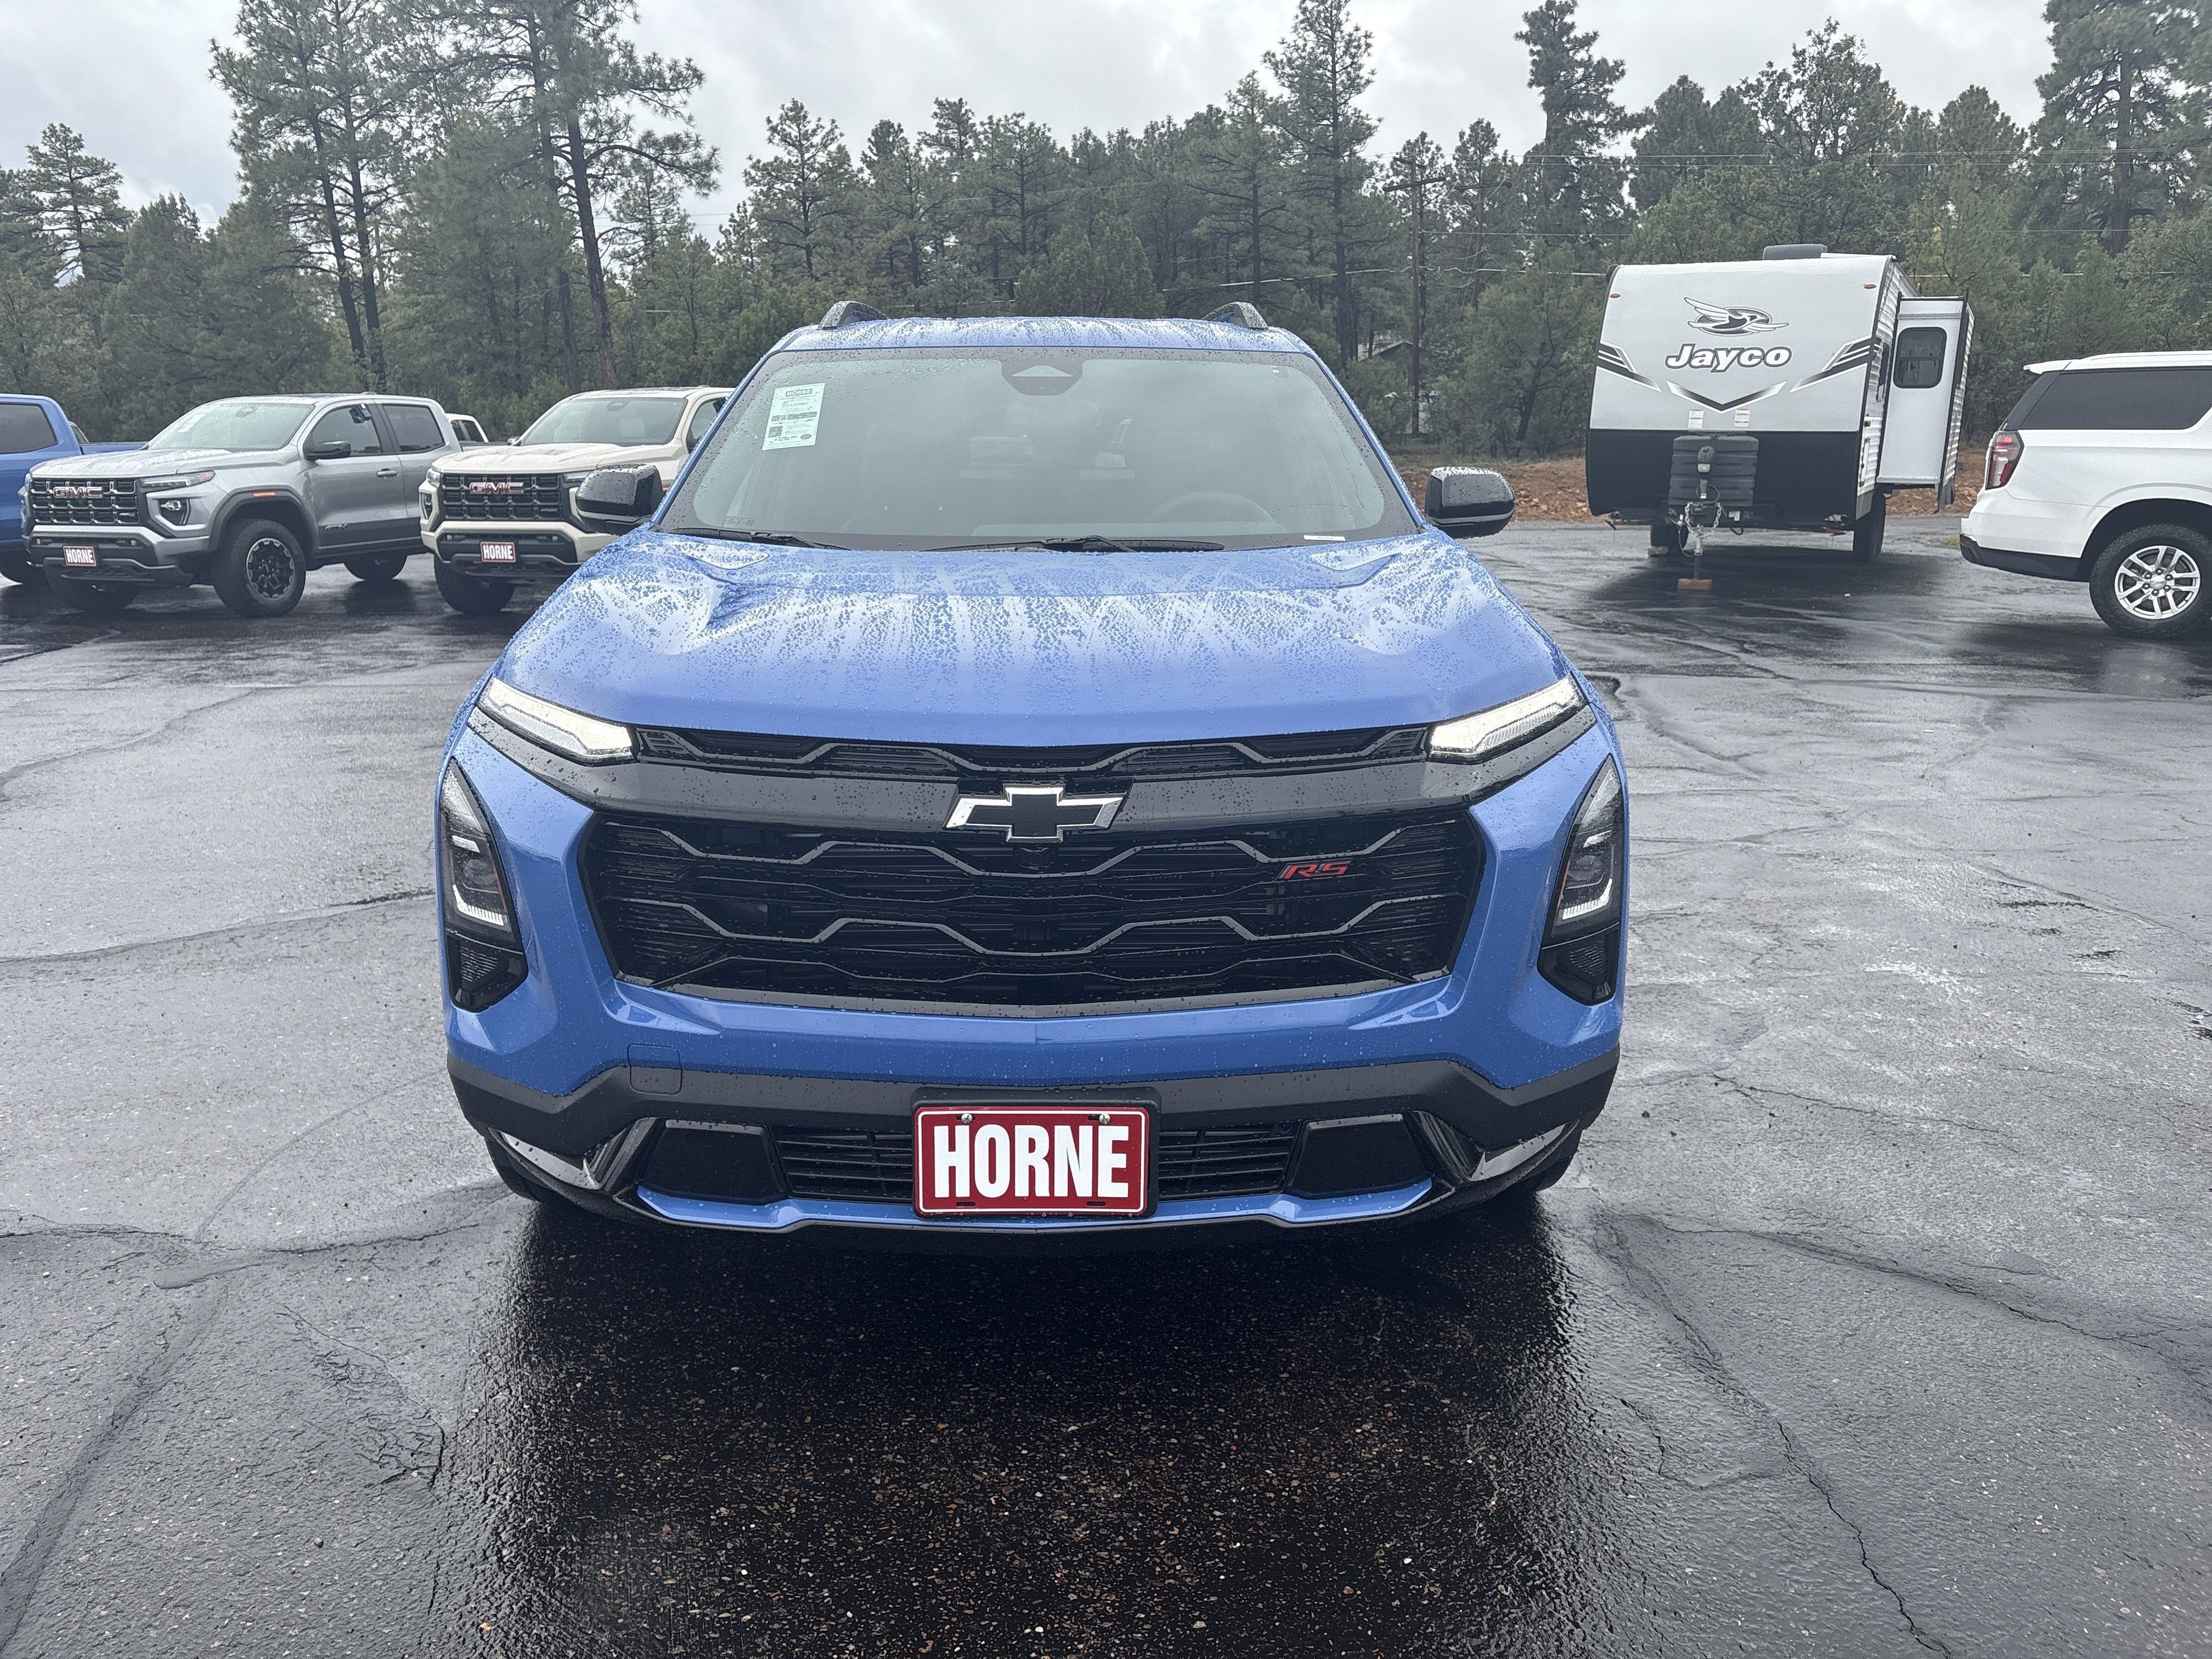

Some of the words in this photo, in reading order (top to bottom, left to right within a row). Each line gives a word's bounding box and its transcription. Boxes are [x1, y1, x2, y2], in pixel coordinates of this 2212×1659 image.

[1665, 343, 1792, 373] Jayco
[53, 486, 103, 498] GMC
[469, 482, 524, 494] GMC
[65, 549, 94, 563] HORNE
[483, 544, 513, 560] HORNE
[1279, 860, 1352, 879] RS
[934, 1124, 1129, 1198] HORNE
